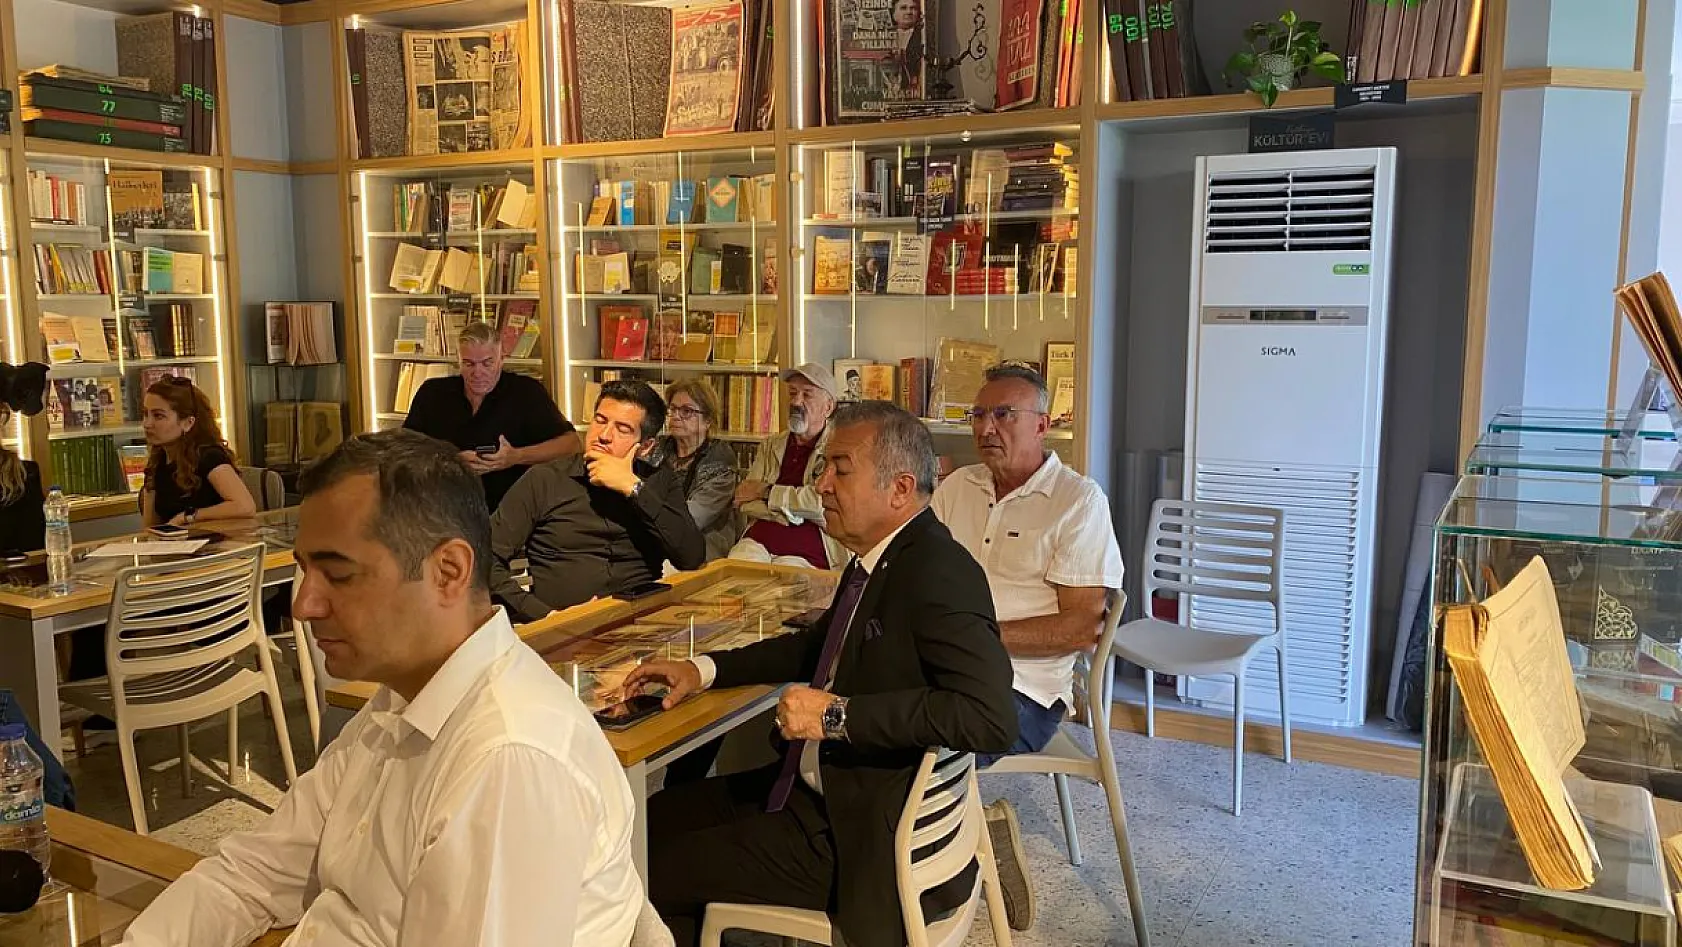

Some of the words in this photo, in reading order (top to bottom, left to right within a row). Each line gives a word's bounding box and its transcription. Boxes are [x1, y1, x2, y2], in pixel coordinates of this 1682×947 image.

[1125, 16, 1139, 43] 100
[101, 101, 116, 112] 77
[99, 133, 112, 144] 75
[1260, 347, 1296, 357] SIGMA
